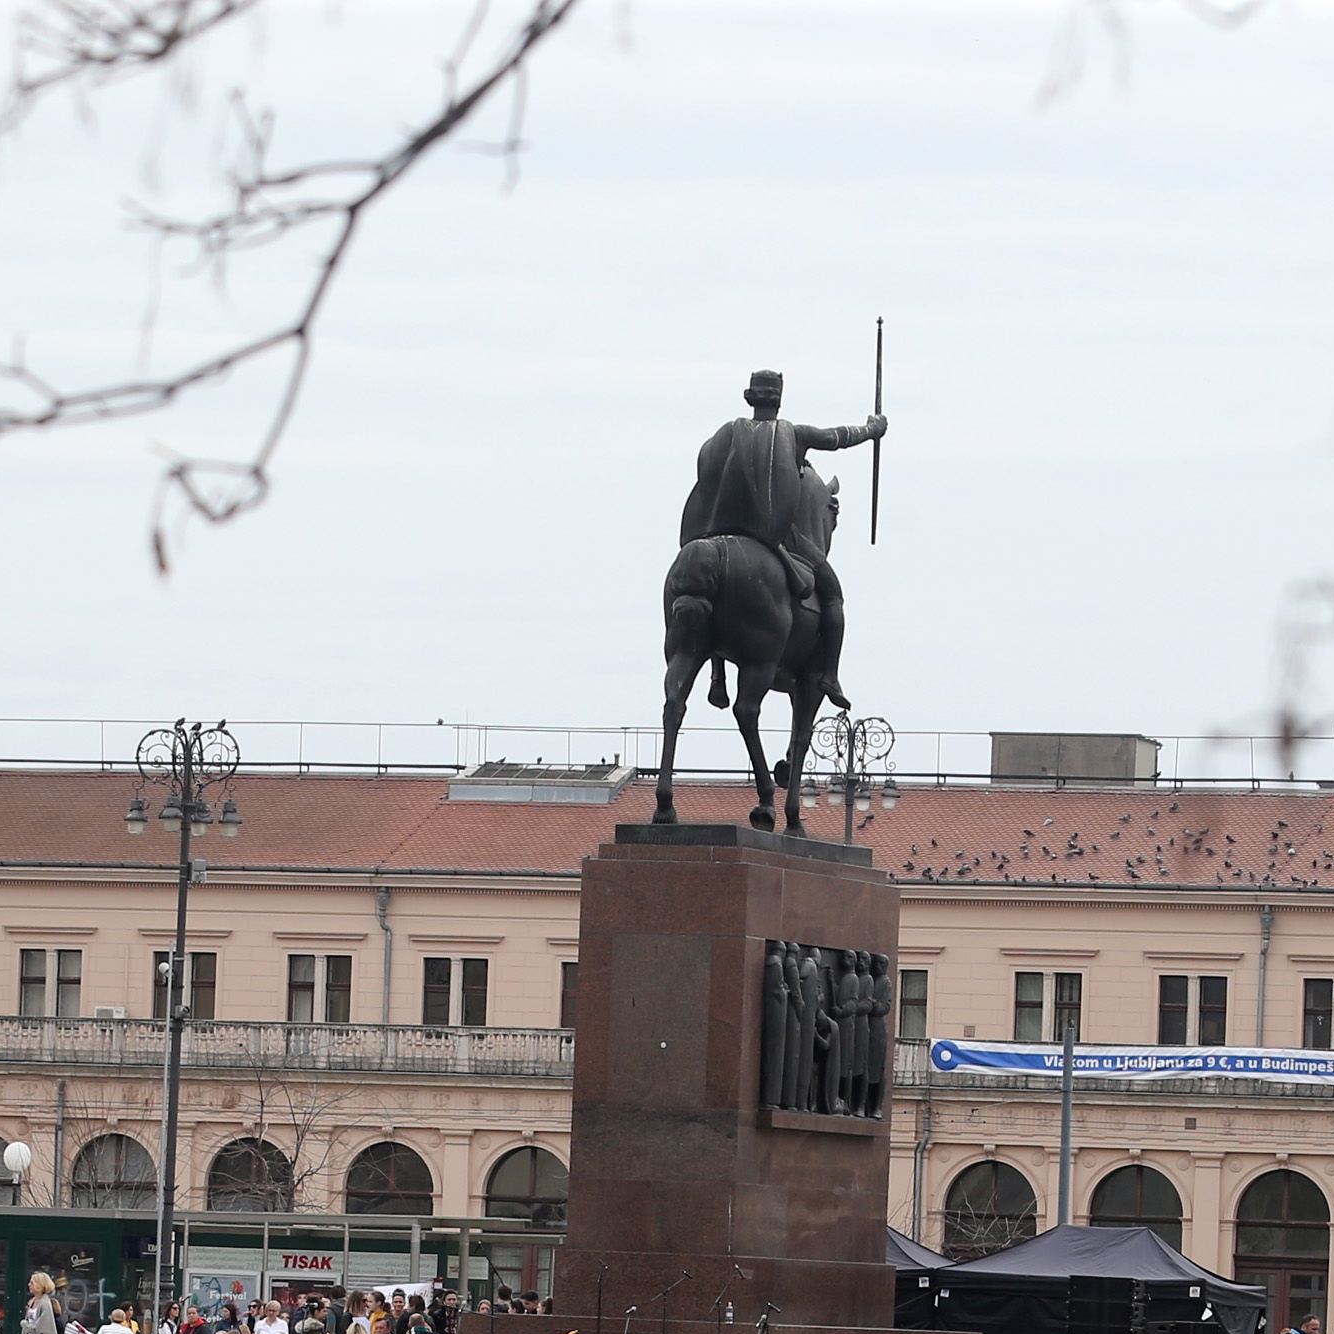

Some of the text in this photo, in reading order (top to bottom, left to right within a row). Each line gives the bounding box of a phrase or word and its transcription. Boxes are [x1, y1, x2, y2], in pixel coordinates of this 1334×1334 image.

[1103, 1059, 1112, 1068] u
[1116, 1056, 1184, 1071] Ljubljanu
[1187, 1058, 1203, 1068] za
[1207, 1056, 1216, 1067] 9
[1235, 1059, 1244, 1069] a
[1248, 1059, 1258, 1069] u
[282, 1254, 334, 1270] TISAK
